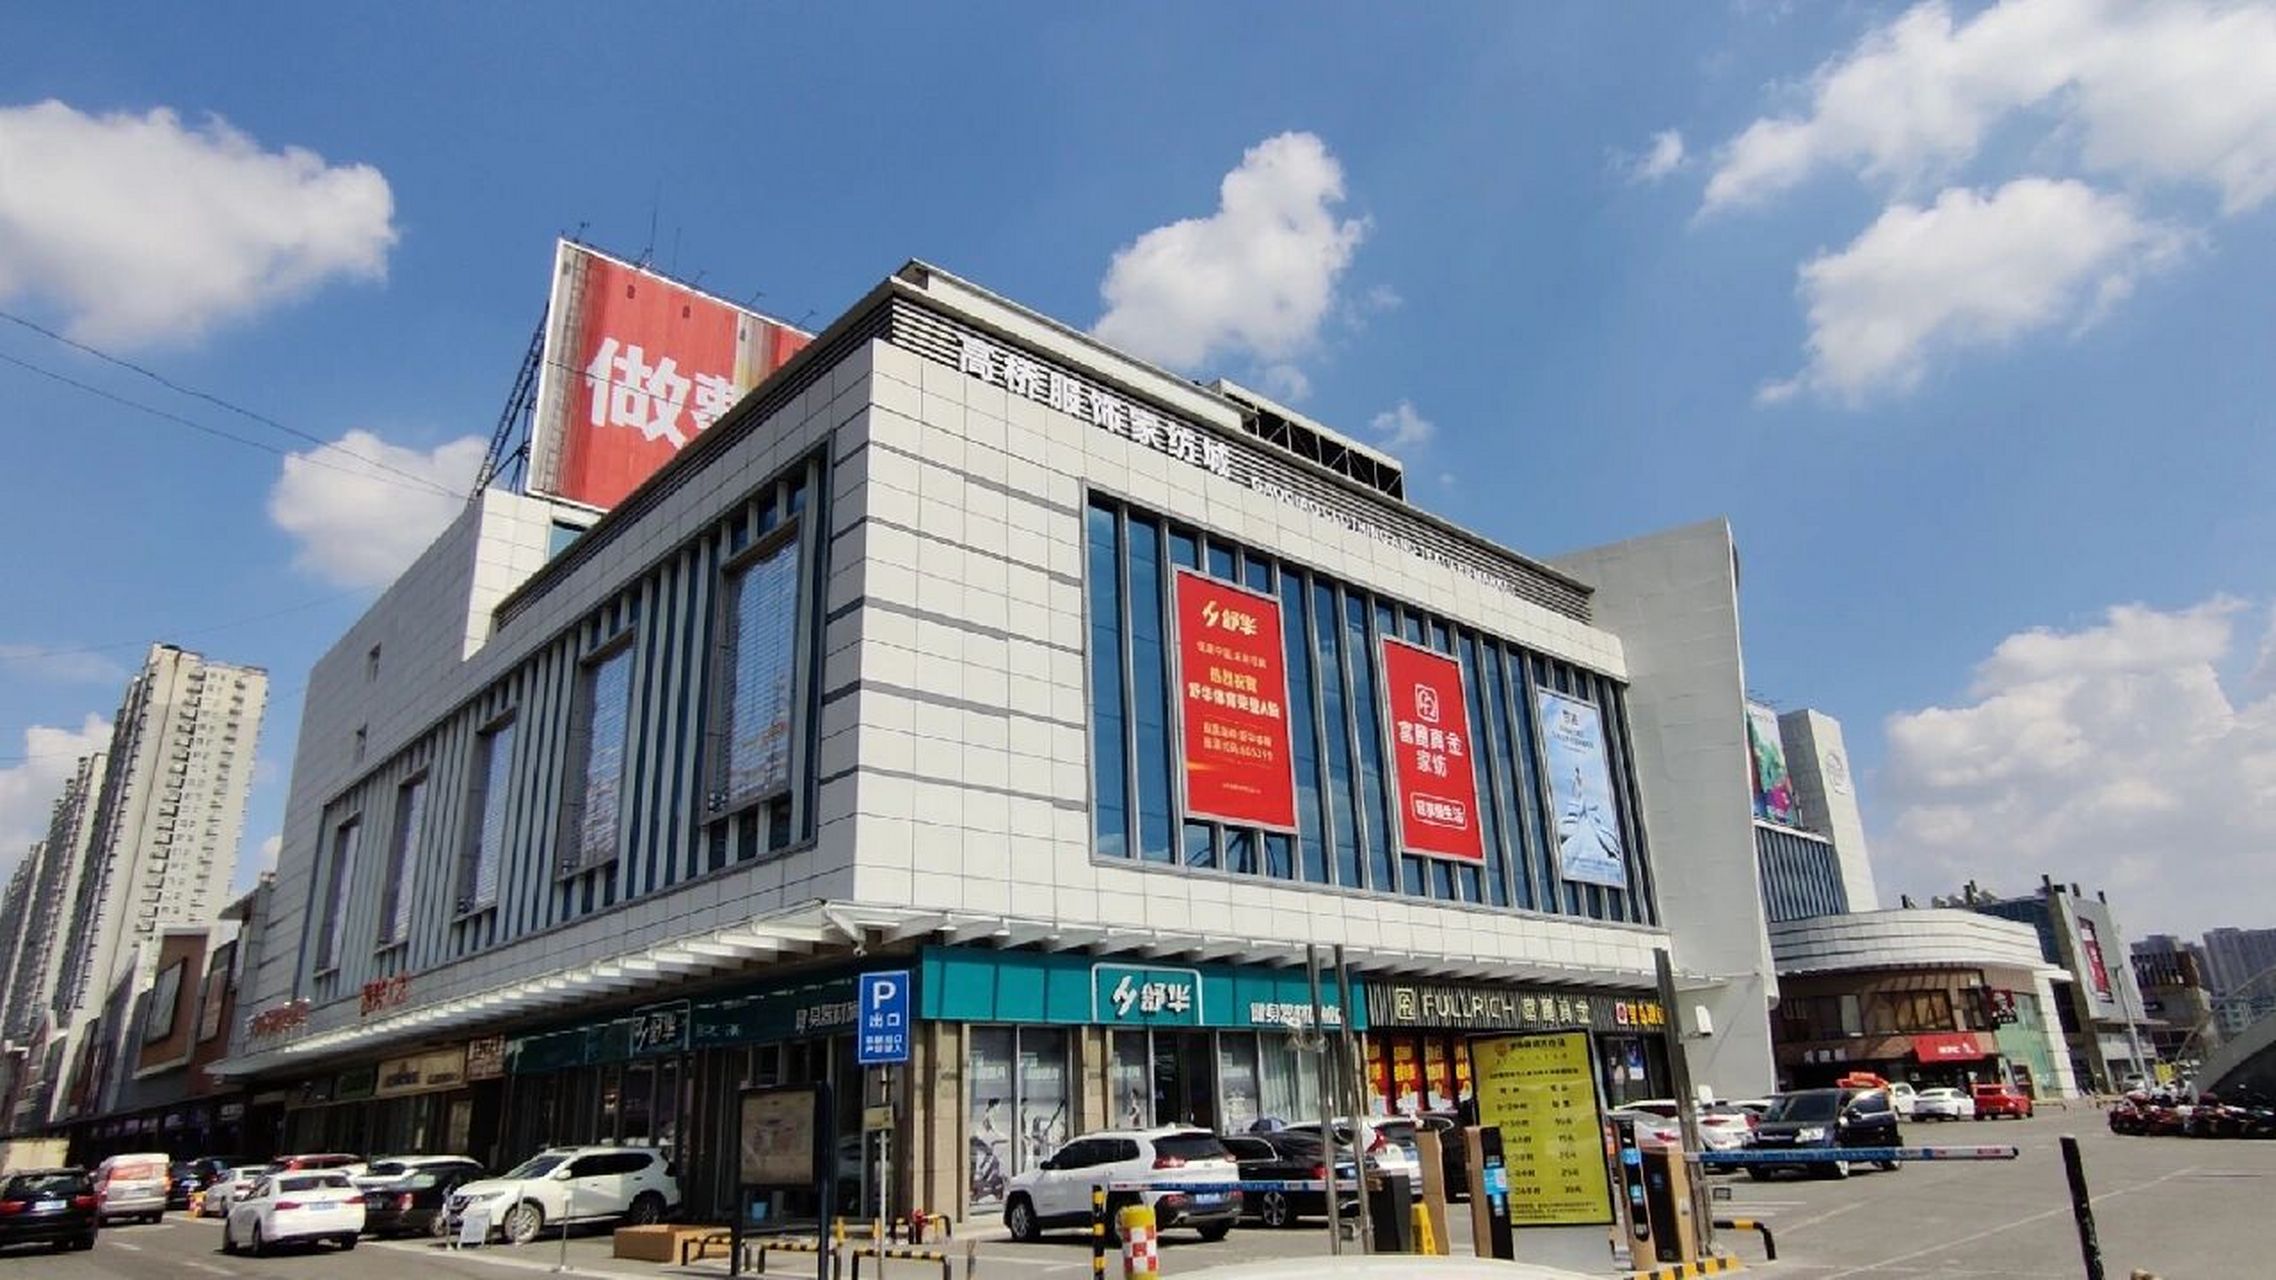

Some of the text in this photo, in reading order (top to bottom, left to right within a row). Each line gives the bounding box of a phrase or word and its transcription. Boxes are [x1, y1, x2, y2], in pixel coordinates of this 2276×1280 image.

[959, 337, 1232, 478] 高桥服饰家纺城
[1222, 609, 1258, 636] 舒华
[873, 981, 897, 1010] P
[1141, 983, 1191, 1012] 舒华
[1423, 995, 1513, 1019] FULLRICH
[869, 1012, 900, 1028] 出口
